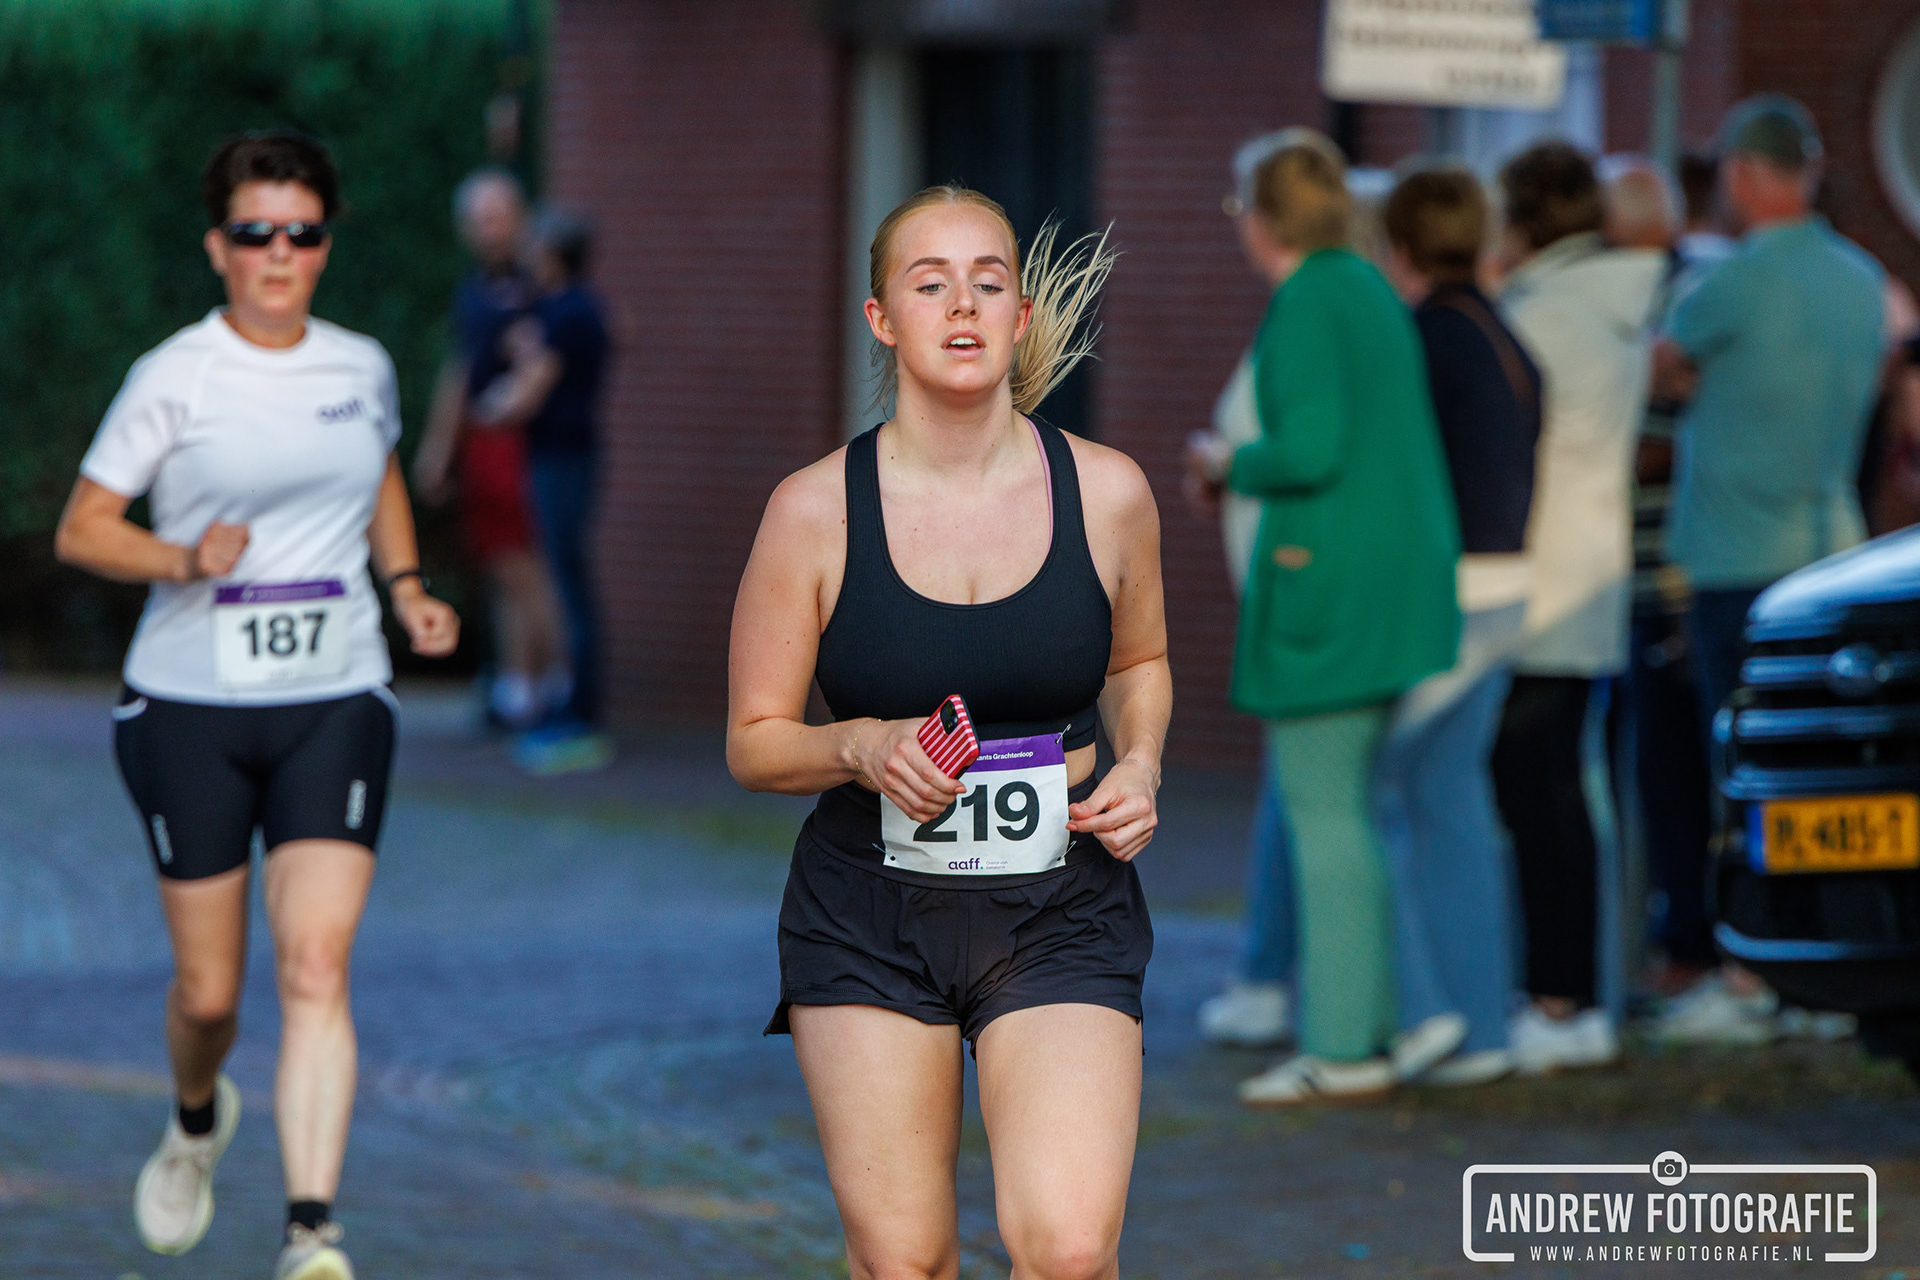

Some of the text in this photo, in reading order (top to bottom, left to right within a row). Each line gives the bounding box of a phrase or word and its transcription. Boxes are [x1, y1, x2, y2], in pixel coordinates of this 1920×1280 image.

[241, 611, 327, 657] 187
[993, 750, 1034, 760] Grachtenloop
[912, 780, 1040, 842] 219
[948, 857, 984, 870] aaff.
